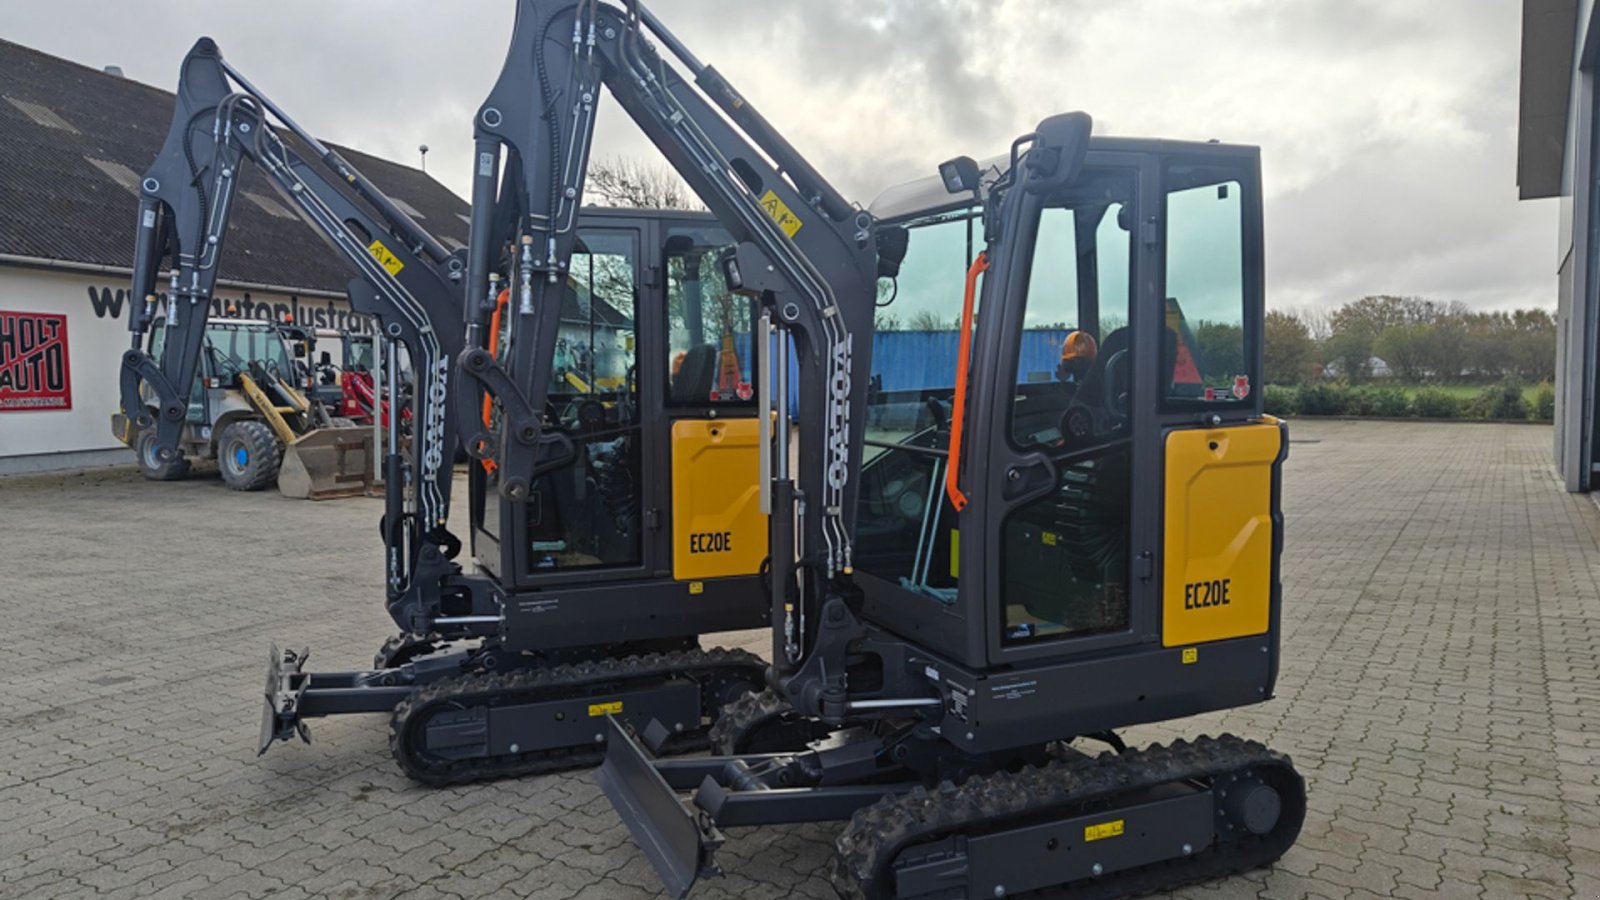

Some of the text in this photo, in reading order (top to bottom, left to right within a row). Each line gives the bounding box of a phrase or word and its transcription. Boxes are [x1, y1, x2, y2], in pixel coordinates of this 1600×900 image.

[0, 341, 64, 391] AUTO
[425, 354, 448, 470] VOLVO
[828, 333, 852, 489] VOLVO
[690, 531, 732, 553] EC20E
[1185, 579, 1231, 610] EC20E
